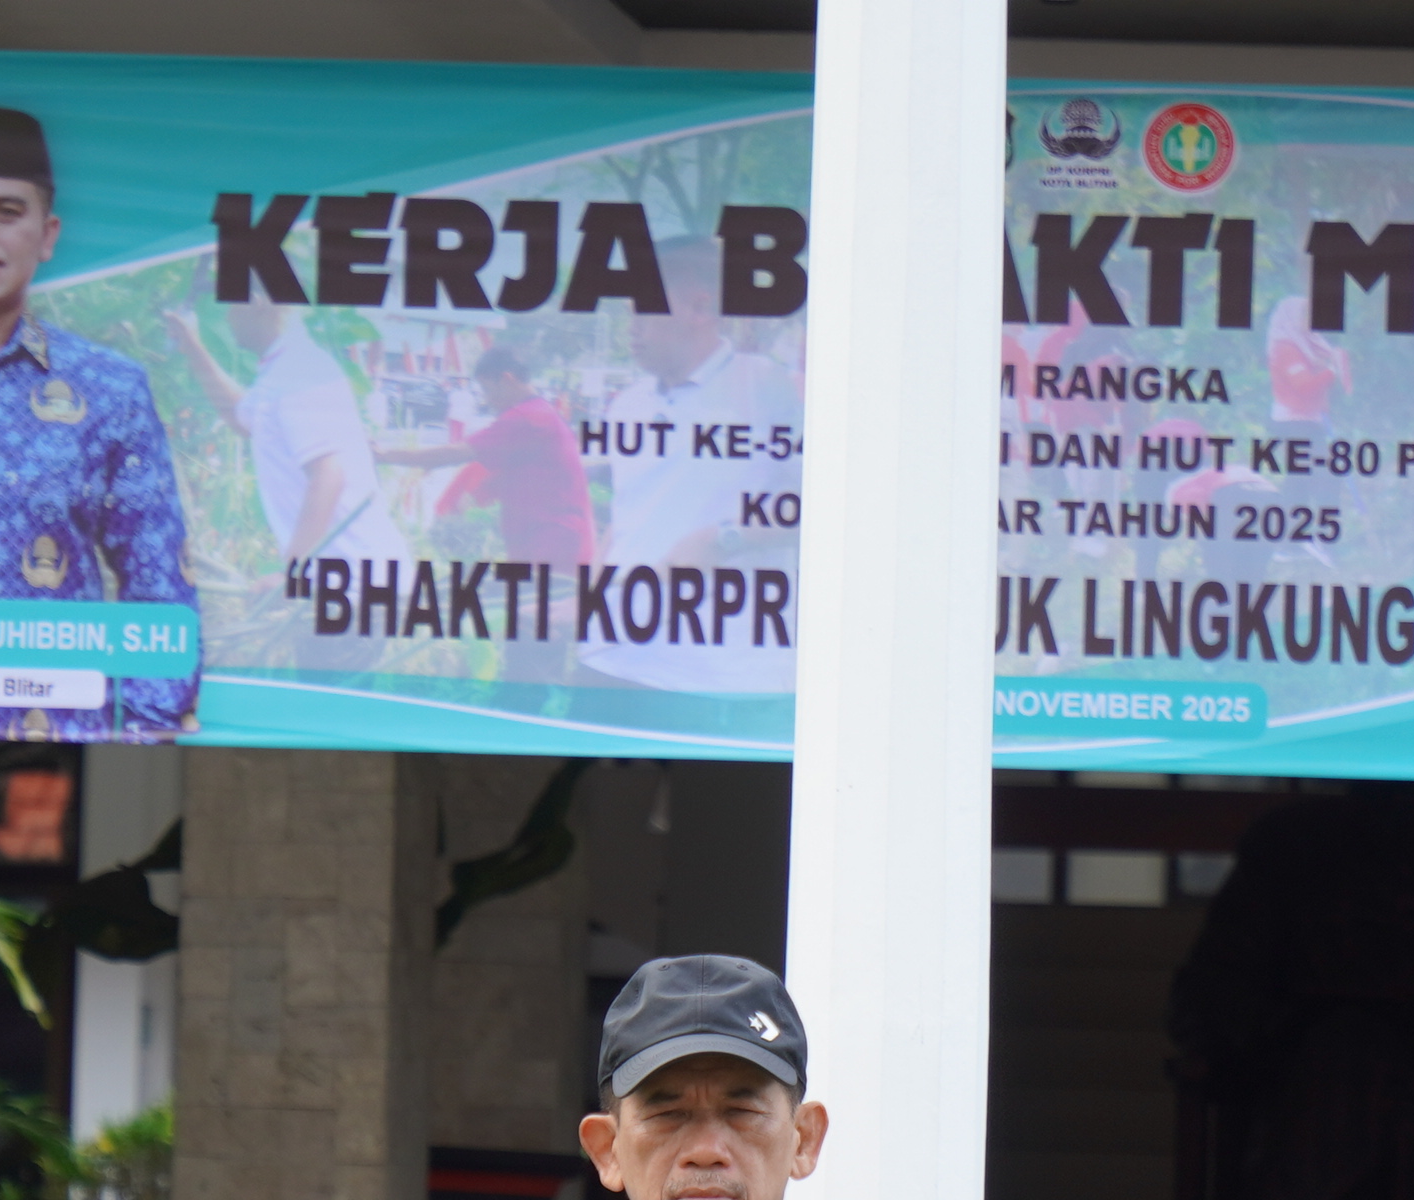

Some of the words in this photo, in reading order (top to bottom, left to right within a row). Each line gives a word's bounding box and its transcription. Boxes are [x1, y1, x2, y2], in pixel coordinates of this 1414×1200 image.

[211, 190, 671, 315] KERJA
[1034, 364, 1230, 404] RANGKA
[580, 421, 675, 456] HUT
[1029, 431, 1121, 468] DAN
[1139, 436, 1235, 473] HUT
[1251, 438, 1381, 477] KE-80
[1060, 500, 1217, 540] TAHUN
[1234, 506, 1341, 543] 2025
[576, 564, 800, 648] KORPR
[122, 622, 188, 655] S.H.I
[3, 678, 54, 699] Blitar
[995, 689, 1173, 721] NOVEMBER
[1181, 695, 1251, 723] 2025
